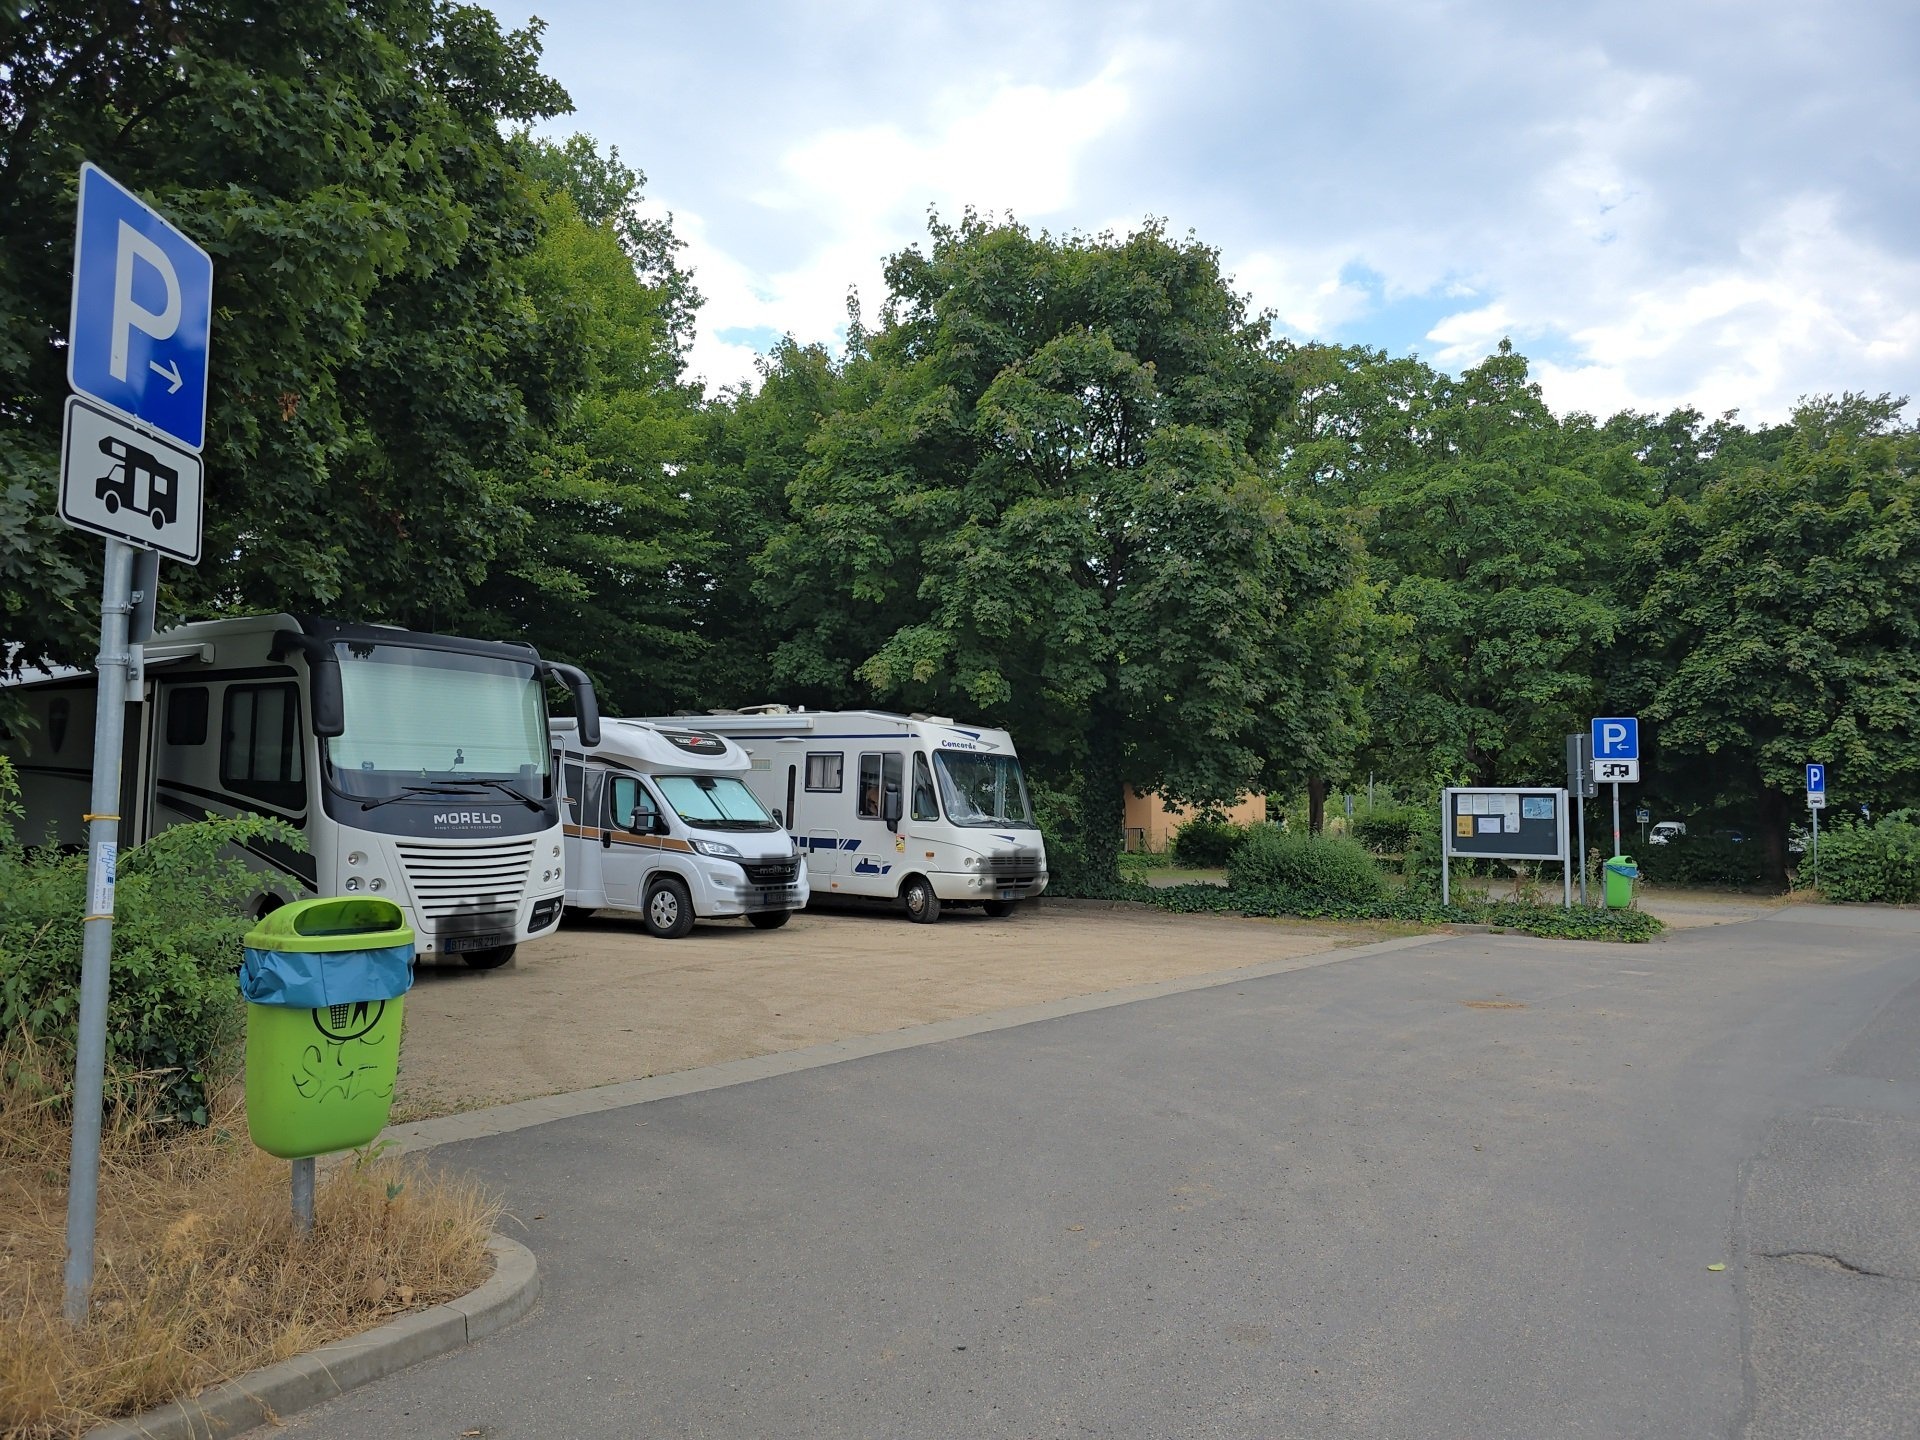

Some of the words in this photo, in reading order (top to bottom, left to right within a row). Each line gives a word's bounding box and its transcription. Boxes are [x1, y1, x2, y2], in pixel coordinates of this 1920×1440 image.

[110, 219, 182, 383] P
[941, 739, 977, 750] Concorde
[1603, 723, 1627, 754] P
[1810, 768, 1821, 789] P
[433, 812, 502, 824] MORELO
[760, 865, 791, 875] malibu
